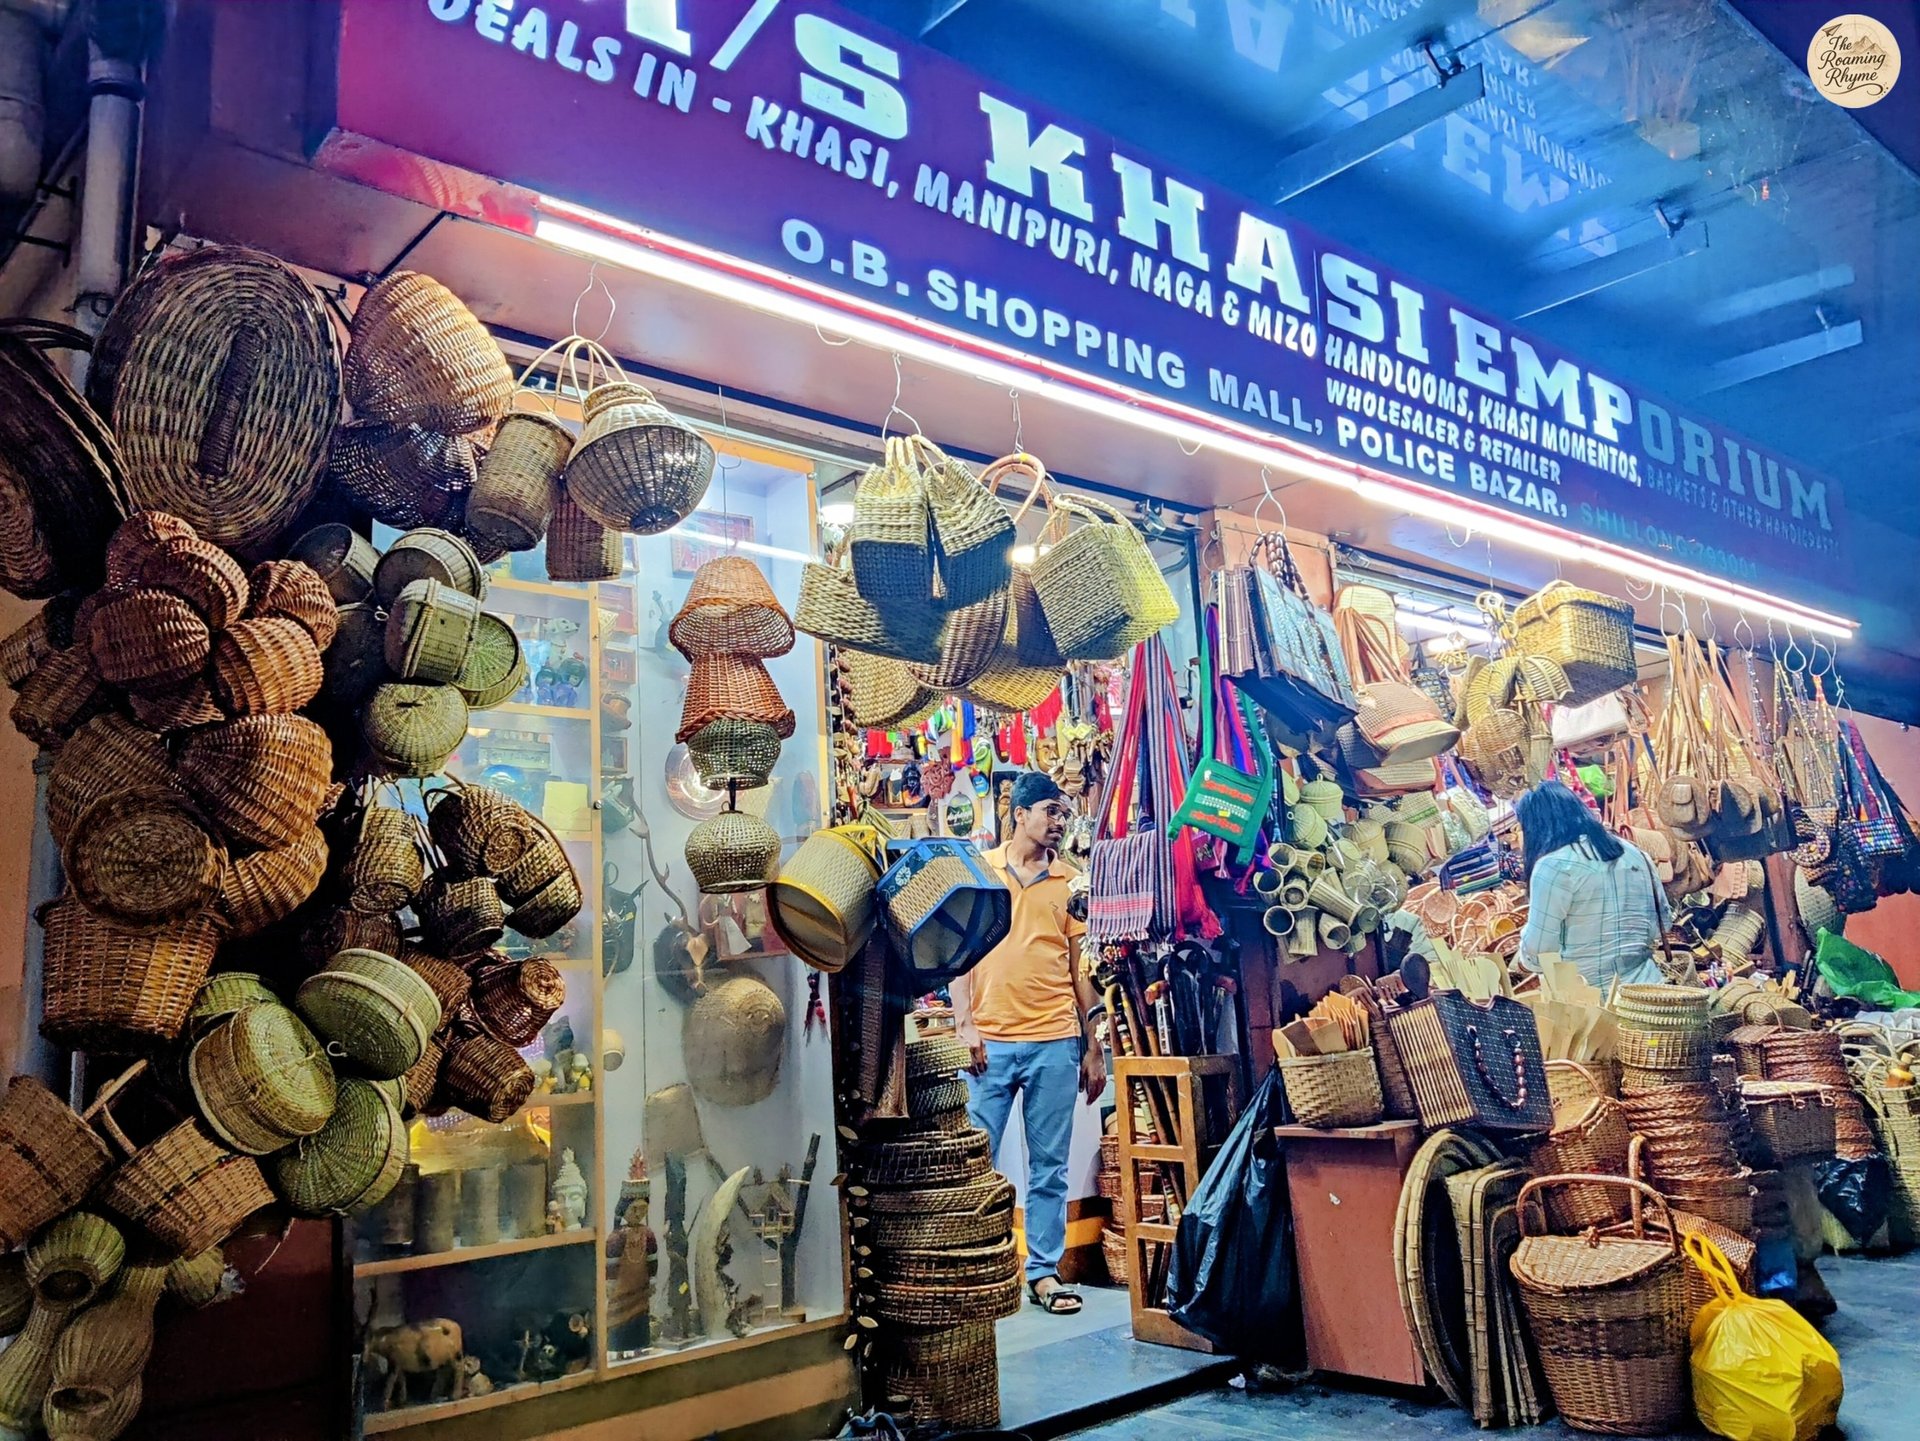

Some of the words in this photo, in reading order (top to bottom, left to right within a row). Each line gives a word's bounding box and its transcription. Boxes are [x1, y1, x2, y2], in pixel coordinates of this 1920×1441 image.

[633, 52, 696, 113] IN
[745, 96, 898, 198] KHASI,
[913, 164, 1118, 285] MANIPURI,
[1131, 252, 1212, 318] NAGA
[1222, 290, 1240, 326] &
[1249, 301, 1317, 357] MIZO
[1325, 333, 1473, 423] HANDLOOMS,
[1479, 394, 1537, 444] KHASI
[1542, 420, 1641, 487] MOMENTOS,
[1647, 464, 1706, 508] BASKETS
[1722, 498, 1762, 532] OTHER
[781, 219, 909, 296] O.B.
[927, 269, 1186, 388] SHOPPING
[1209, 367, 1323, 435] MALL,
[1337, 416, 1456, 482] POLICE
[1469, 462, 1567, 518] BAZAR,
[979, 91, 1428, 364] KHASI
[1449, 307, 1832, 531] EMPORIUM
[1326, 378, 1459, 449] WHOLESALER
[1464, 430, 1475, 452] &
[1480, 435, 1561, 485] RETAILER
